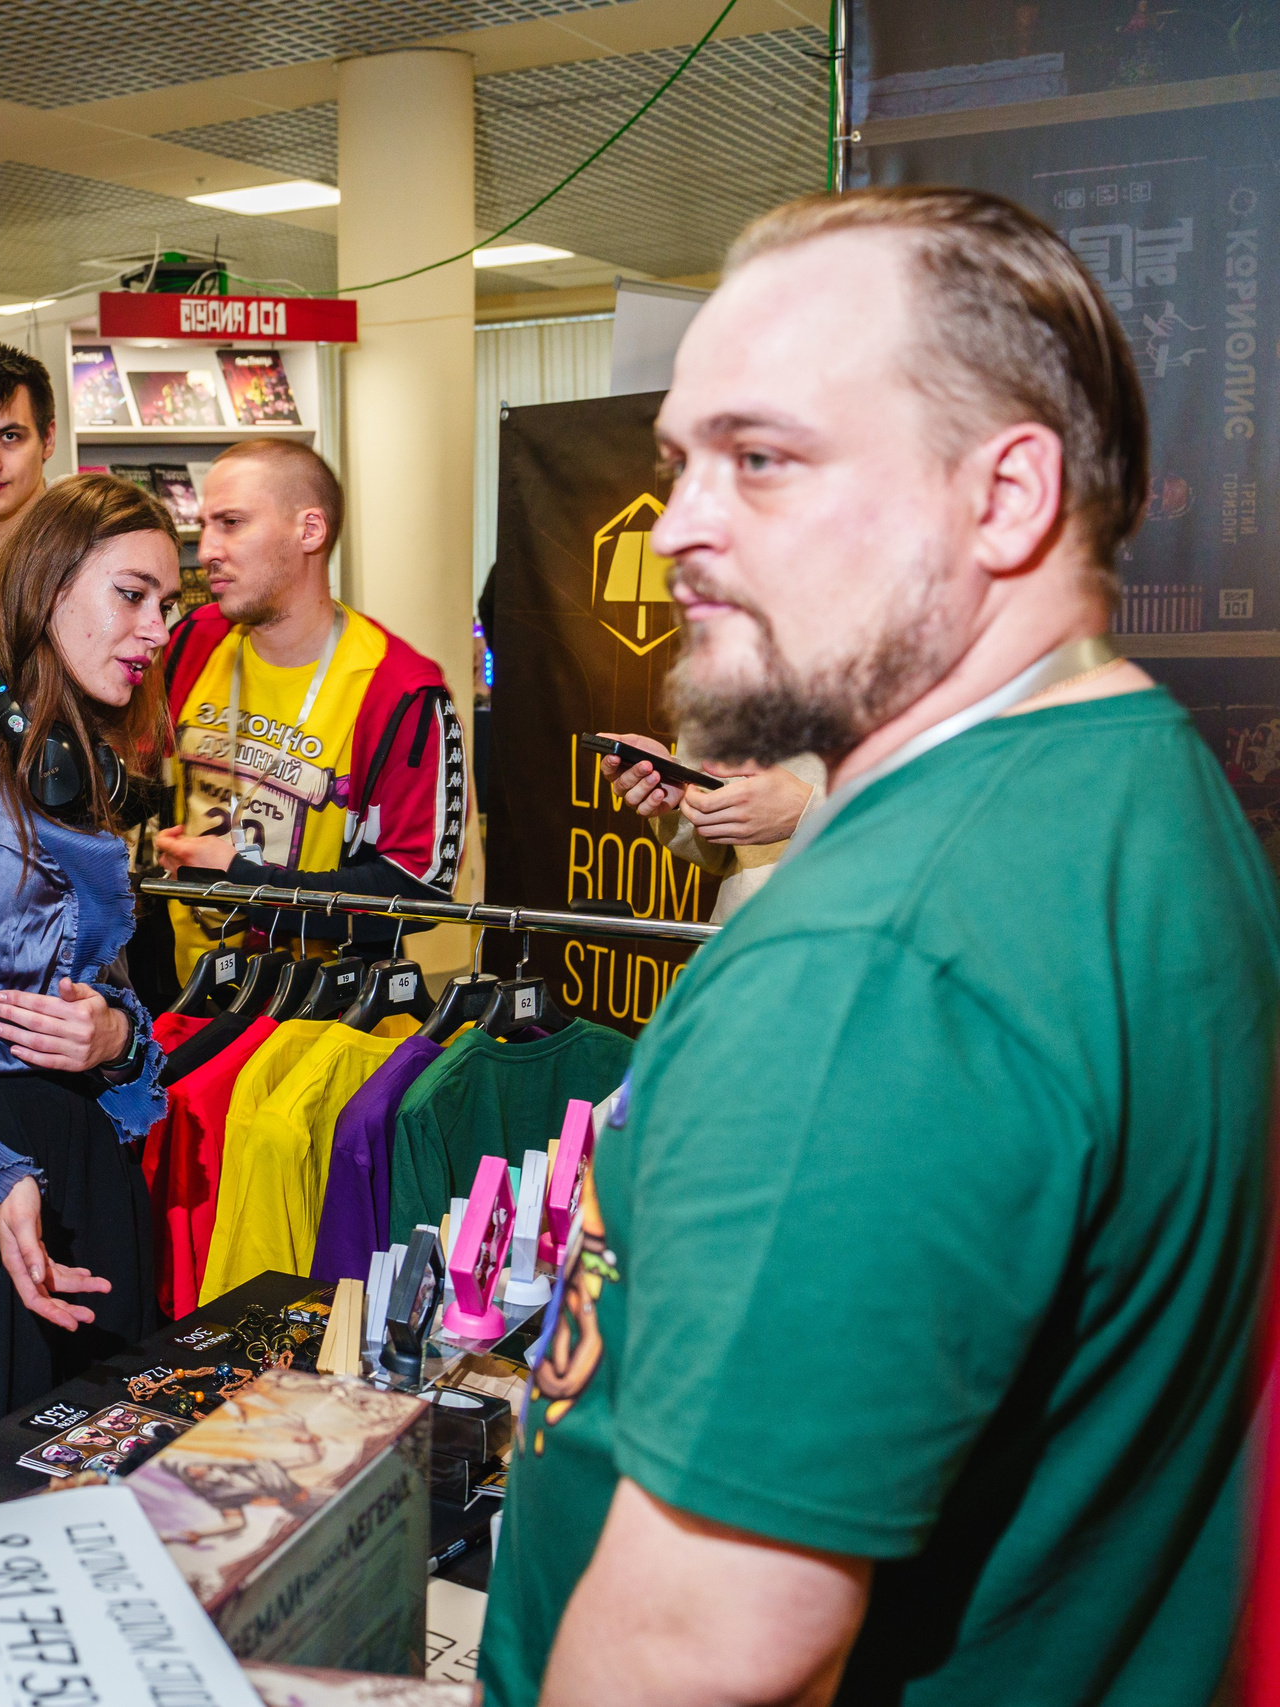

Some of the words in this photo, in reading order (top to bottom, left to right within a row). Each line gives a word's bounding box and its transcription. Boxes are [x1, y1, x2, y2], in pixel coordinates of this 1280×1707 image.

[180, 298, 245, 333] СТУДИЯ
[247, 301, 287, 335] 101
[197, 702, 323, 759] ЗАКОННО
[568, 828, 701, 922] ROOM
[219, 958, 234, 972] 135
[342, 975, 350, 983] 19
[398, 976, 410, 988] 46
[521, 997, 532, 1009] 62
[64, 1520, 144, 1594] LIVING
